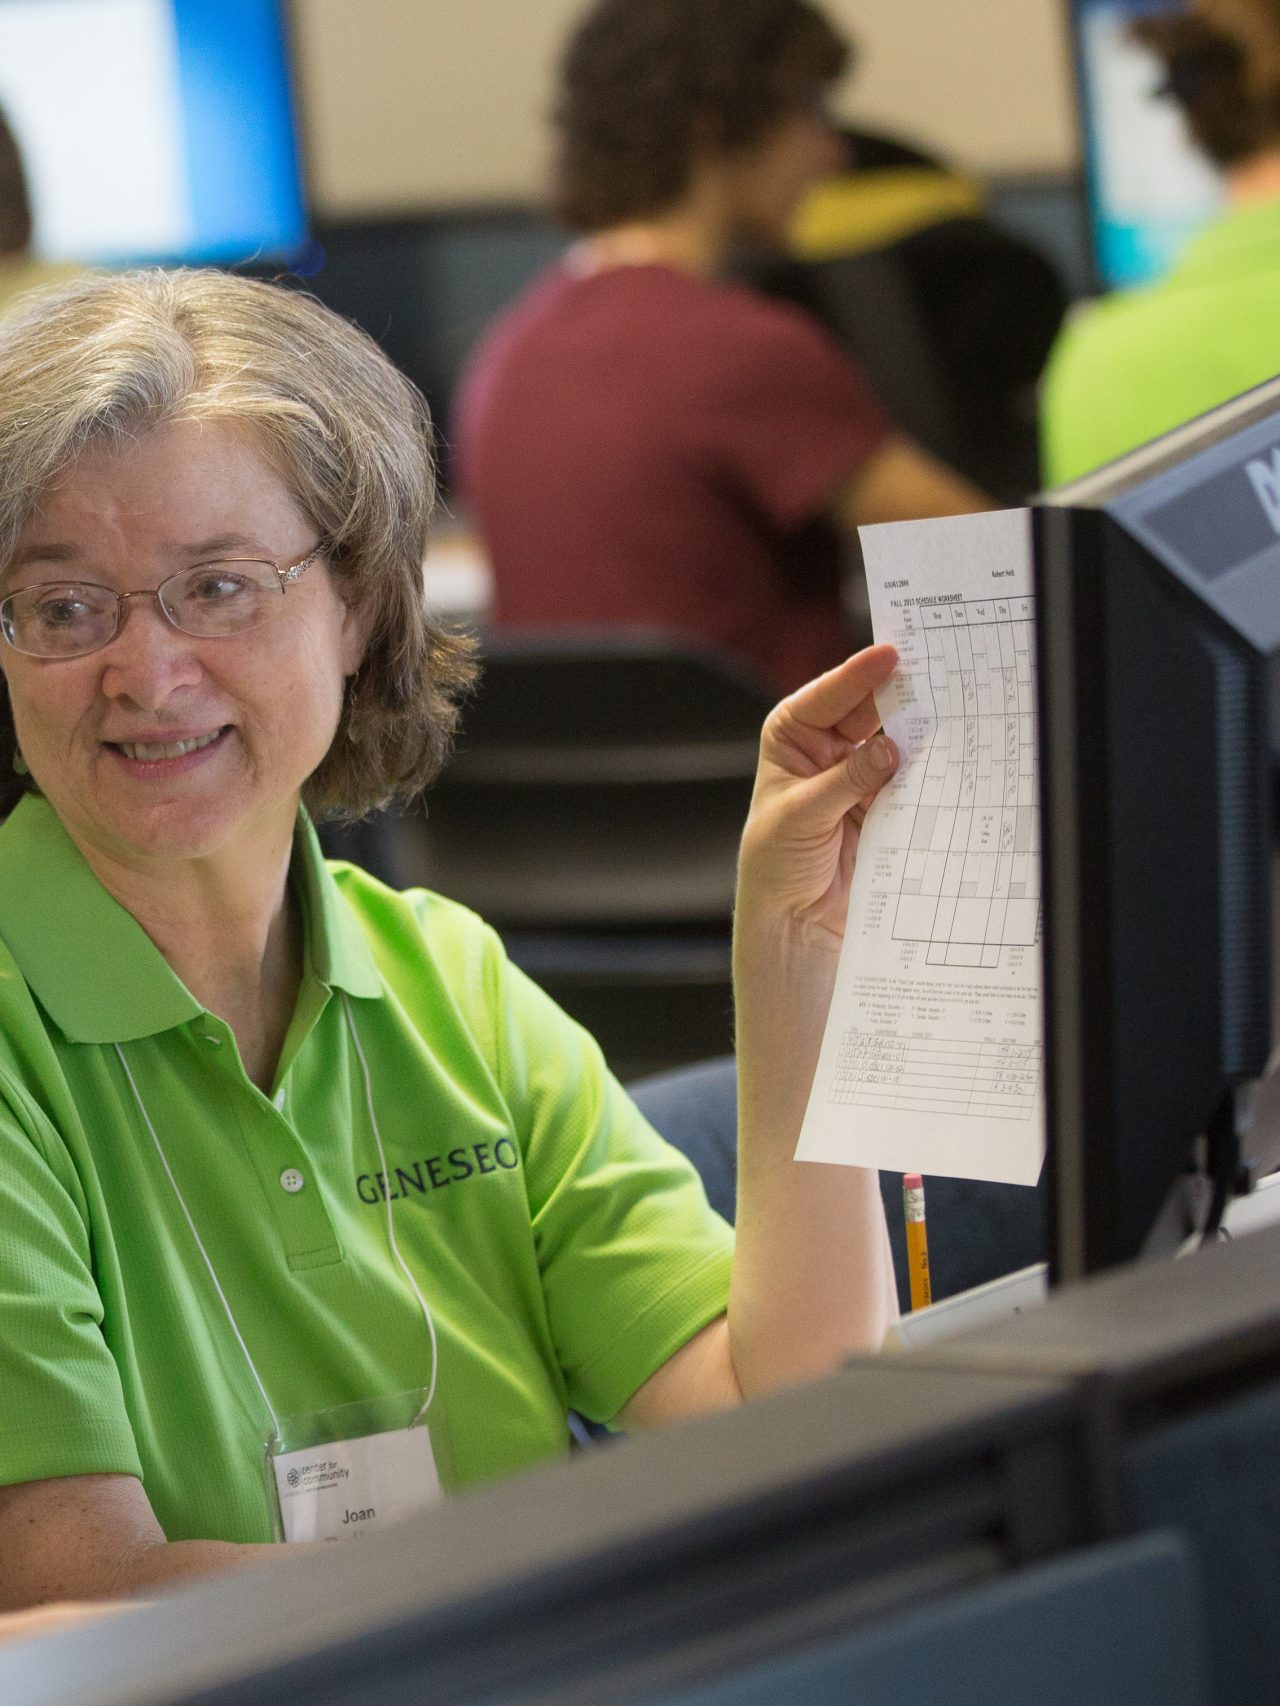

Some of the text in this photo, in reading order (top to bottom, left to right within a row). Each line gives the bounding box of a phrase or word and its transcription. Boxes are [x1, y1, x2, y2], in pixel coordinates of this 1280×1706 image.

[890, 599, 902, 608] FALL
[915, 595, 937, 605] SCHEDULE
[938, 593, 963, 603] WORKSHEET
[356, 1137, 519, 1205] GENESEO
[301, 1461, 338, 1475] center for
[303, 1468, 350, 1486] community
[342, 1507, 376, 1525] Joan
